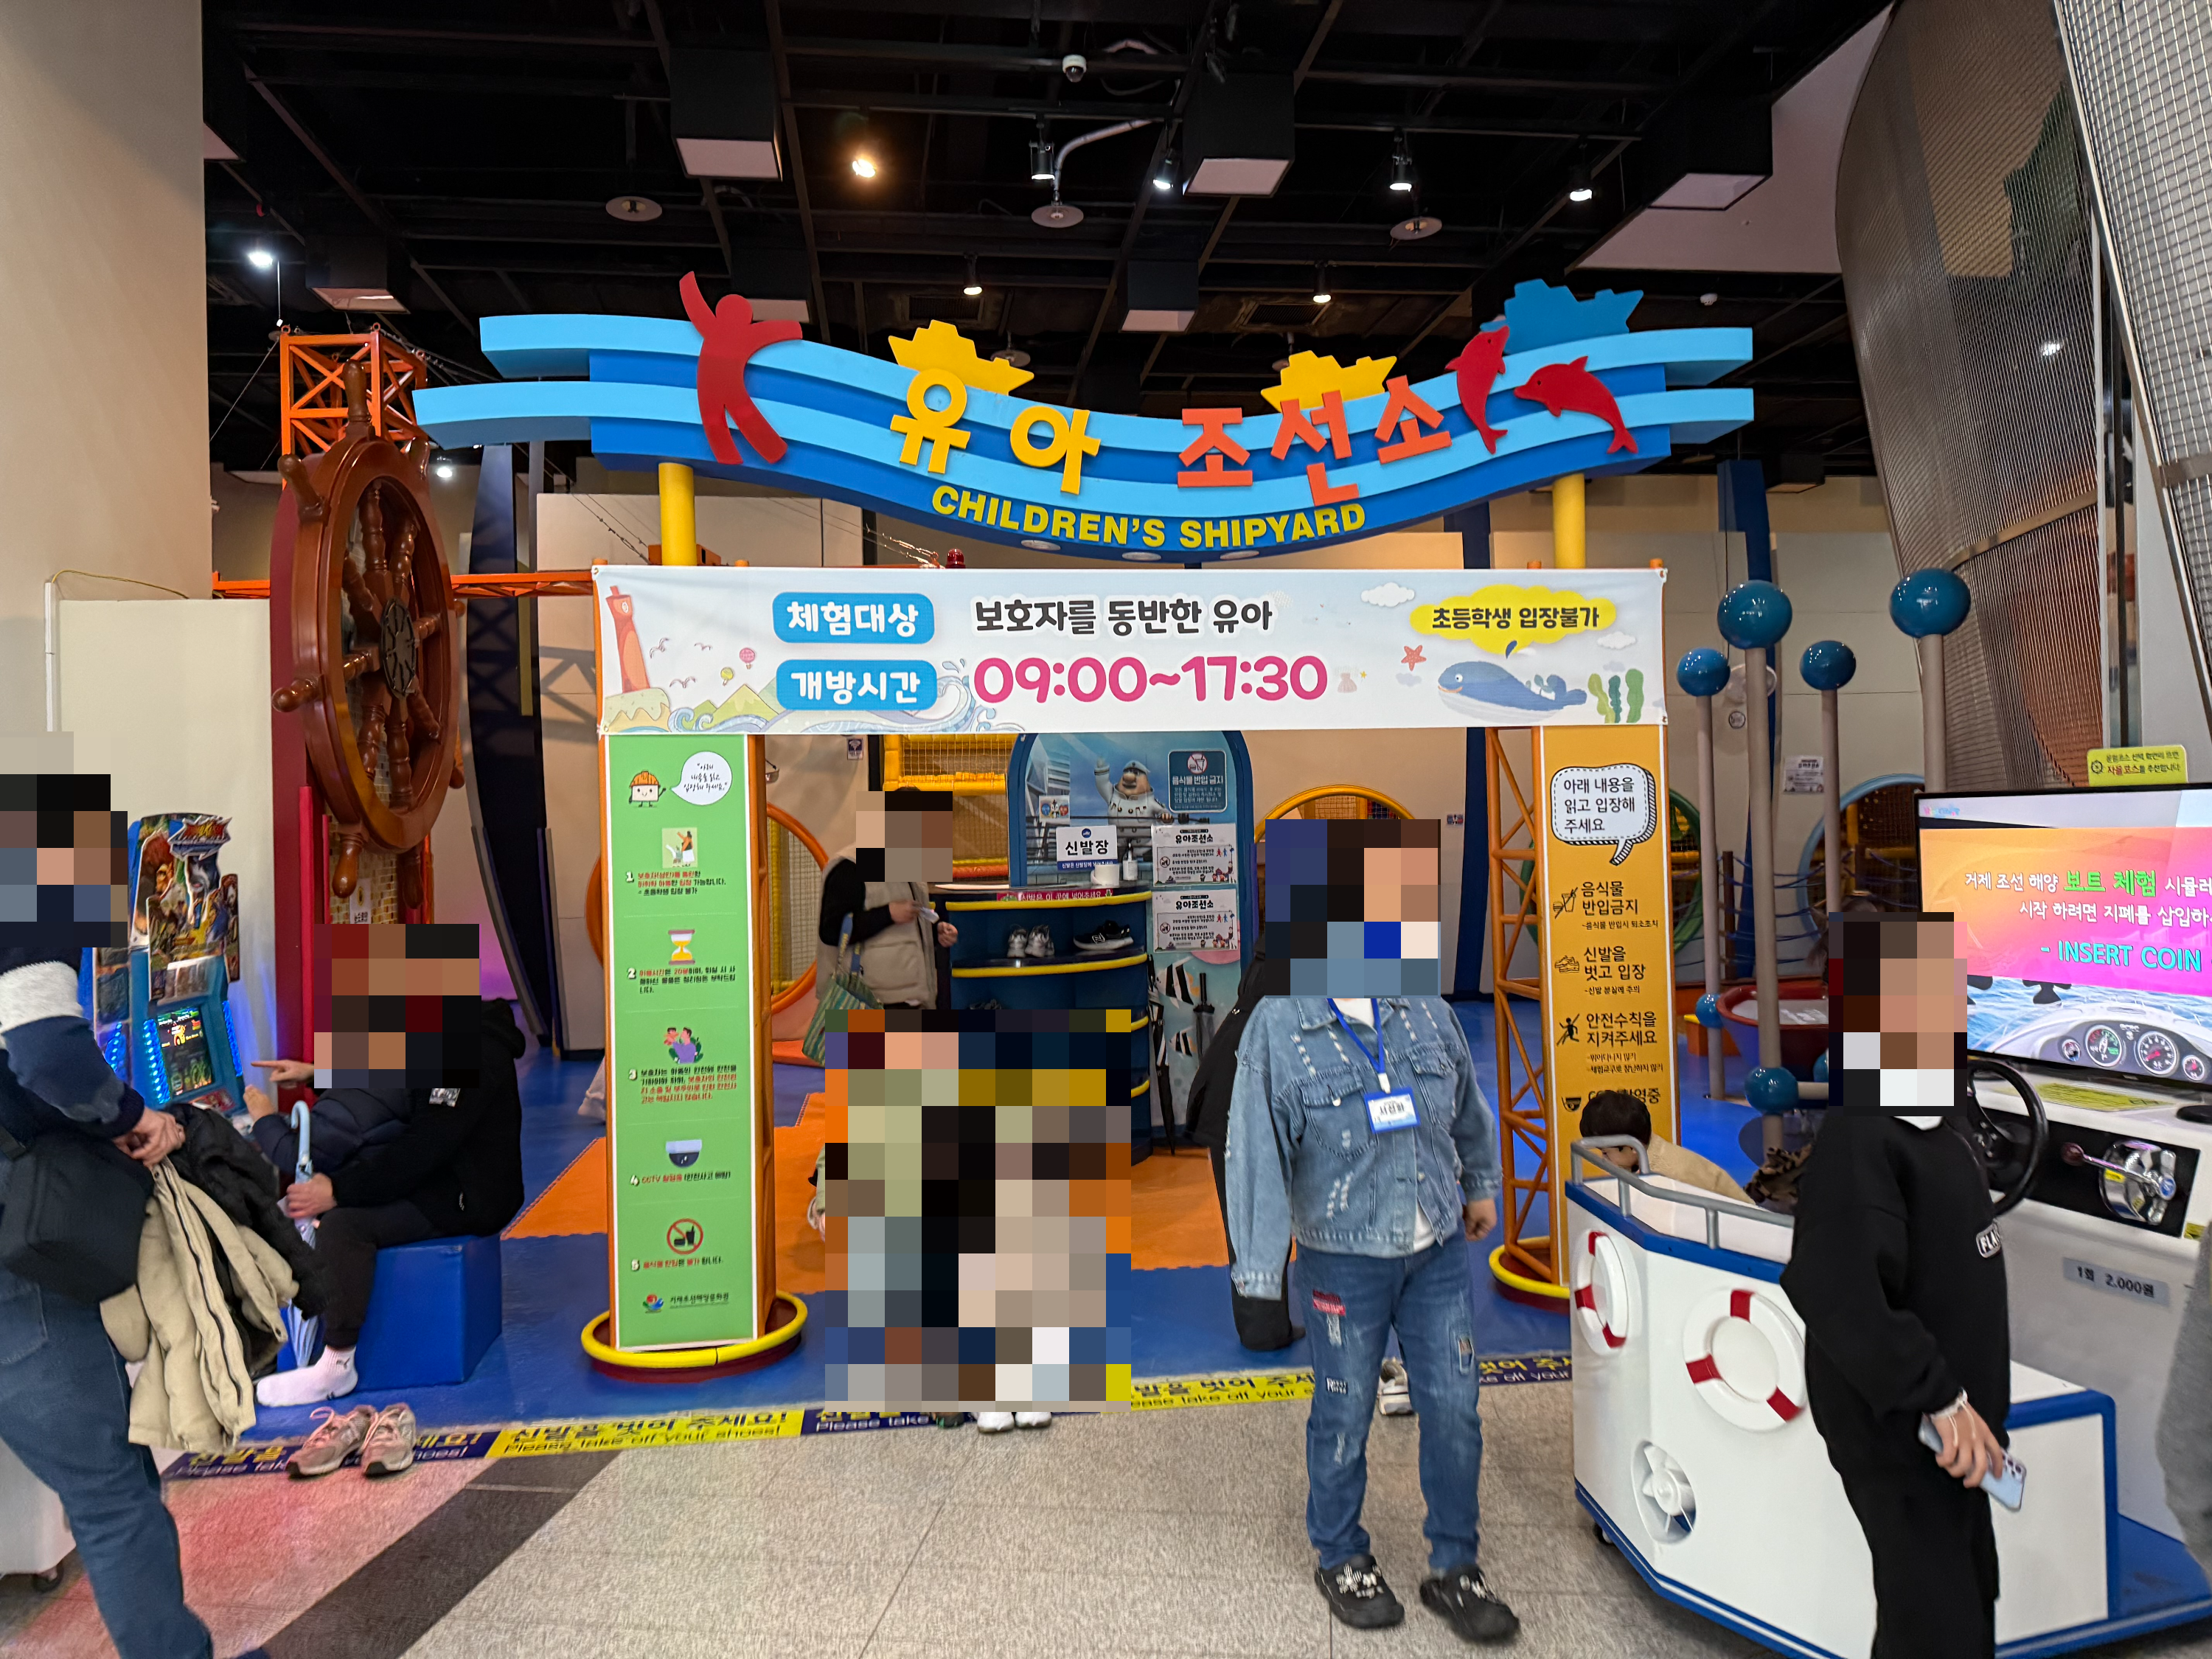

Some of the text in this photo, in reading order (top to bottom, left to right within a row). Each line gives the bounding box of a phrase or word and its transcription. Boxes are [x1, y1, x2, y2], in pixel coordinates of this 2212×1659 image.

[890, 368, 1453, 507] 유아 조선소
[932, 484, 1366, 549] CHILDREN'S SHIPYARD
[787, 599, 919, 637] 체험대상
[975, 598, 1273, 636] 보호자를 동반한 유아
[1432, 606, 1600, 630] 초등학생 입장불가
[791, 670, 920, 705] 개방시간
[974, 655, 1328, 703] 09:00~17:30
[1194, 775, 1208, 785] 반입
[1209, 775, 1223, 785] 금지
[1564, 776, 1635, 794] 아래 내용을
[1565, 796, 1635, 814] 읽고 입장해
[1564, 818, 1605, 834] 주세요
[1065, 839, 1109, 856] 신발장
[1175, 834, 1213, 844] 유아조선소
[626, 872, 635, 883] 1
[1965, 871, 1992, 890] 거제
[1996, 872, 2024, 892] 조선
[2028, 873, 2059, 893] 해양
[2064, 870, 2106, 892] 보트
[2113, 869, 2156, 897] 체험
[1581, 881, 1624, 897] 음식물
[1175, 900, 1214, 910] 유아조선소
[1582, 899, 1638, 916] 반입금지
[2020, 900, 2212, 928] 시작 하려면 지폐를 삽입하
[1585, 945, 1626, 963] 신발을
[2058, 939, 2133, 967] INSERT
[2141, 946, 2202, 972] COIN
[627, 967, 636, 979] 2
[1585, 963, 1646, 981] 벗고 입장
[1586, 1011, 1657, 1029] 안전수칙을
[1587, 1030, 1657, 1048] 지켜주세요
[816, 1418, 880, 1432] Please
